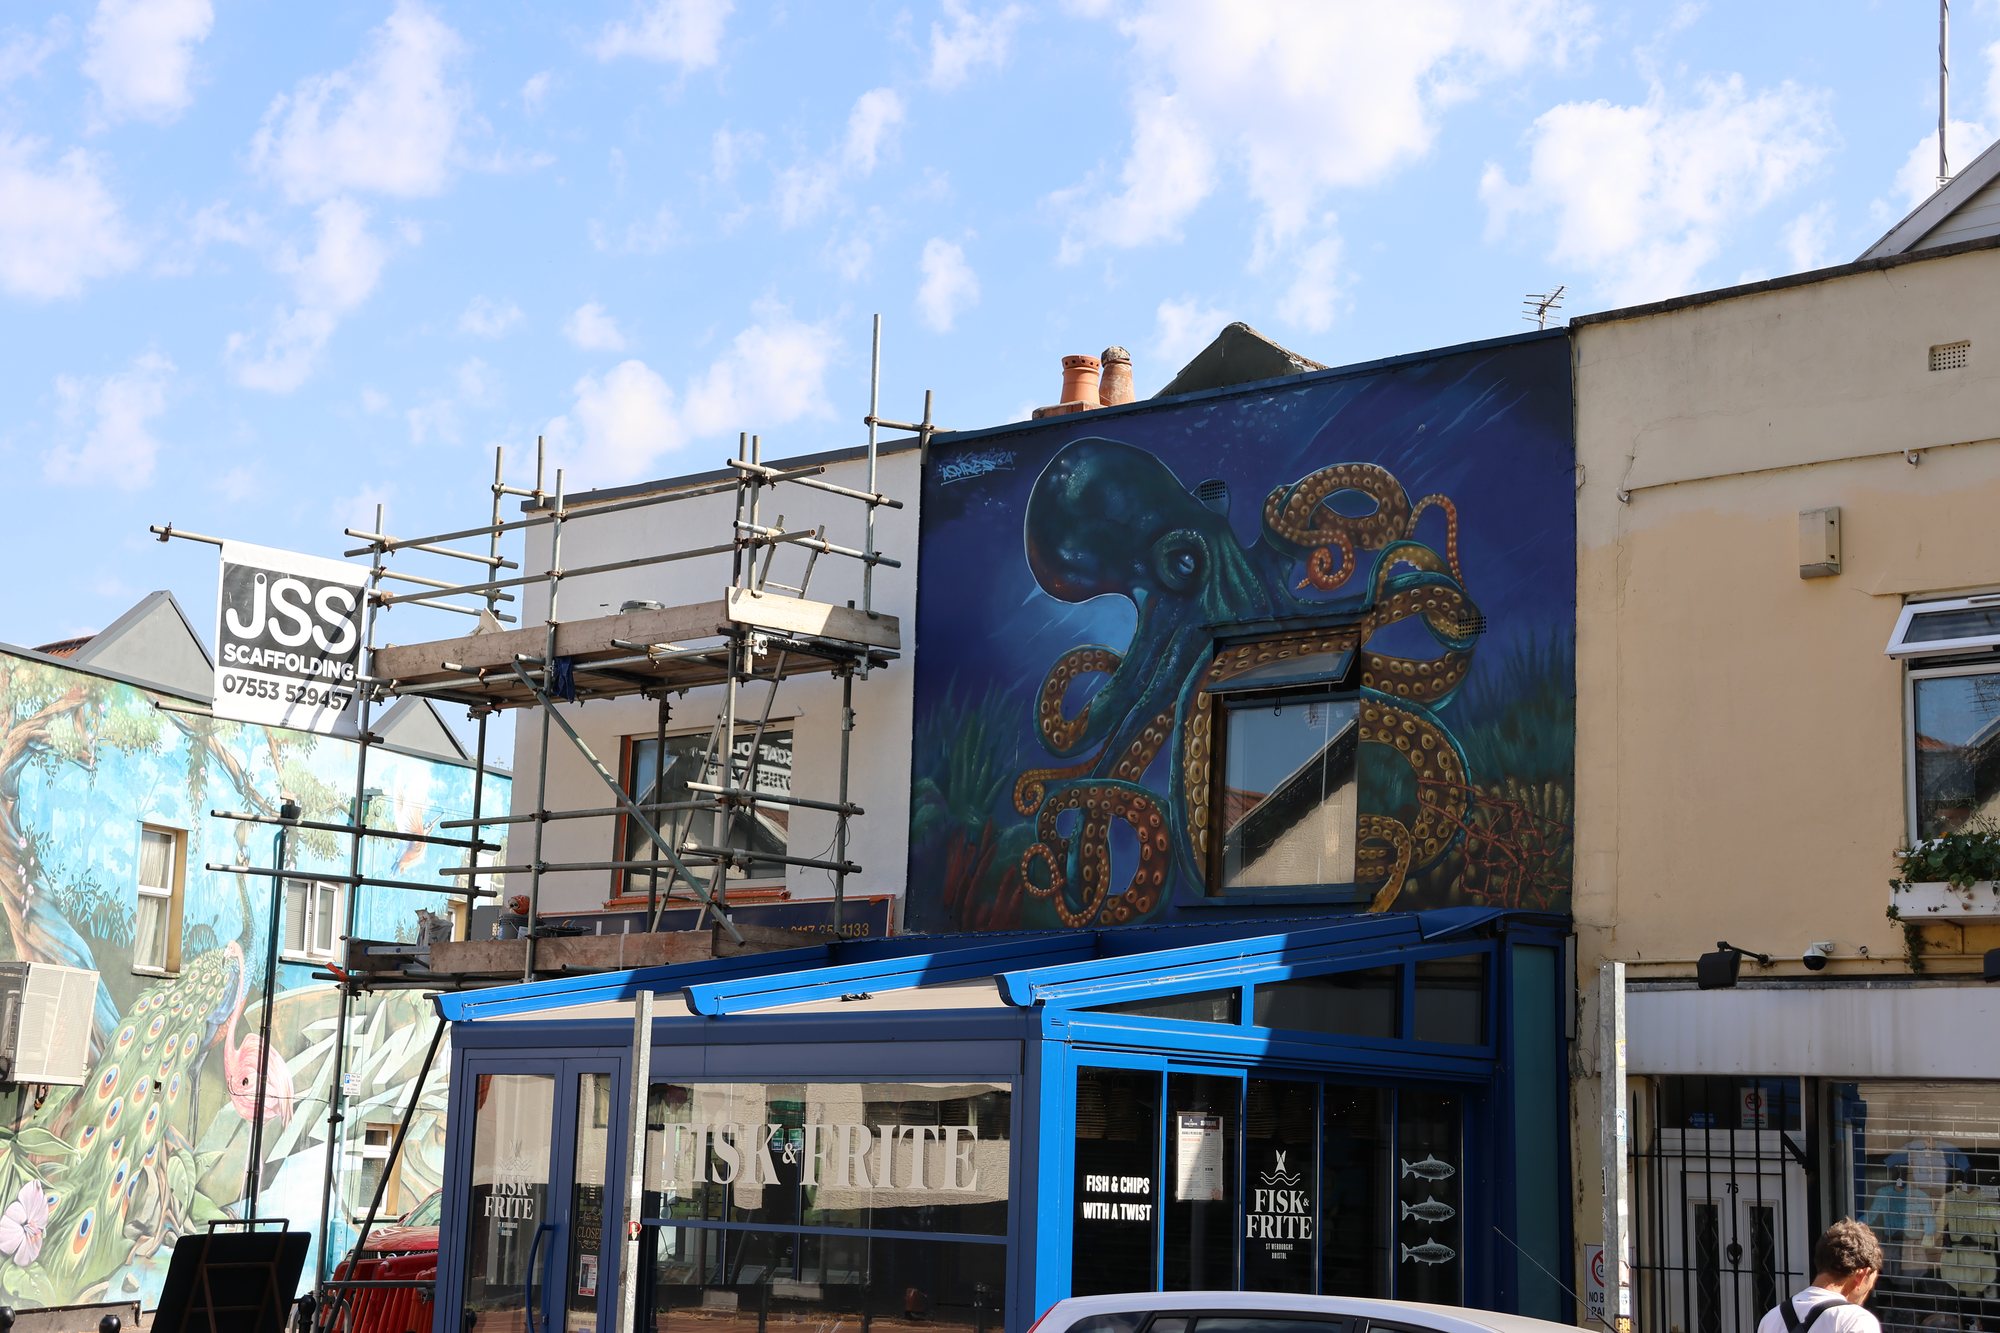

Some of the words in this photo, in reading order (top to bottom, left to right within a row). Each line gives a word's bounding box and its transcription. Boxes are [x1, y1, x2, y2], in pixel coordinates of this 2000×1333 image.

[225, 572, 357, 655] JSS
[223, 643, 354, 681] SCAFFOLDING
[222, 673, 280, 701] 07553
[285, 683, 353, 712] 529457
[842, 922, 869, 937] 1133
[661, 1122, 782, 1186] FISK
[782, 1142, 798, 1164] &
[800, 1123, 979, 1192] FRITE
[491, 1174, 529, 1196] FISK
[1086, 1174, 1110, 1192] FISH
[1111, 1175, 1119, 1193] &
[1120, 1176, 1150, 1195] CHIPS
[484, 1195, 534, 1220] FRITE
[1082, 1201, 1110, 1219] WITH
[1111, 1203, 1119, 1220] A
[1120, 1203, 1152, 1221] TWIST
[1254, 1188, 1305, 1214] FISK
[1302, 1197, 1310, 1207] &
[577, 1226, 602, 1241] CLOSE
[1246, 1214, 1313, 1240] FRITE
[1588, 1291, 1599, 1303] NO
